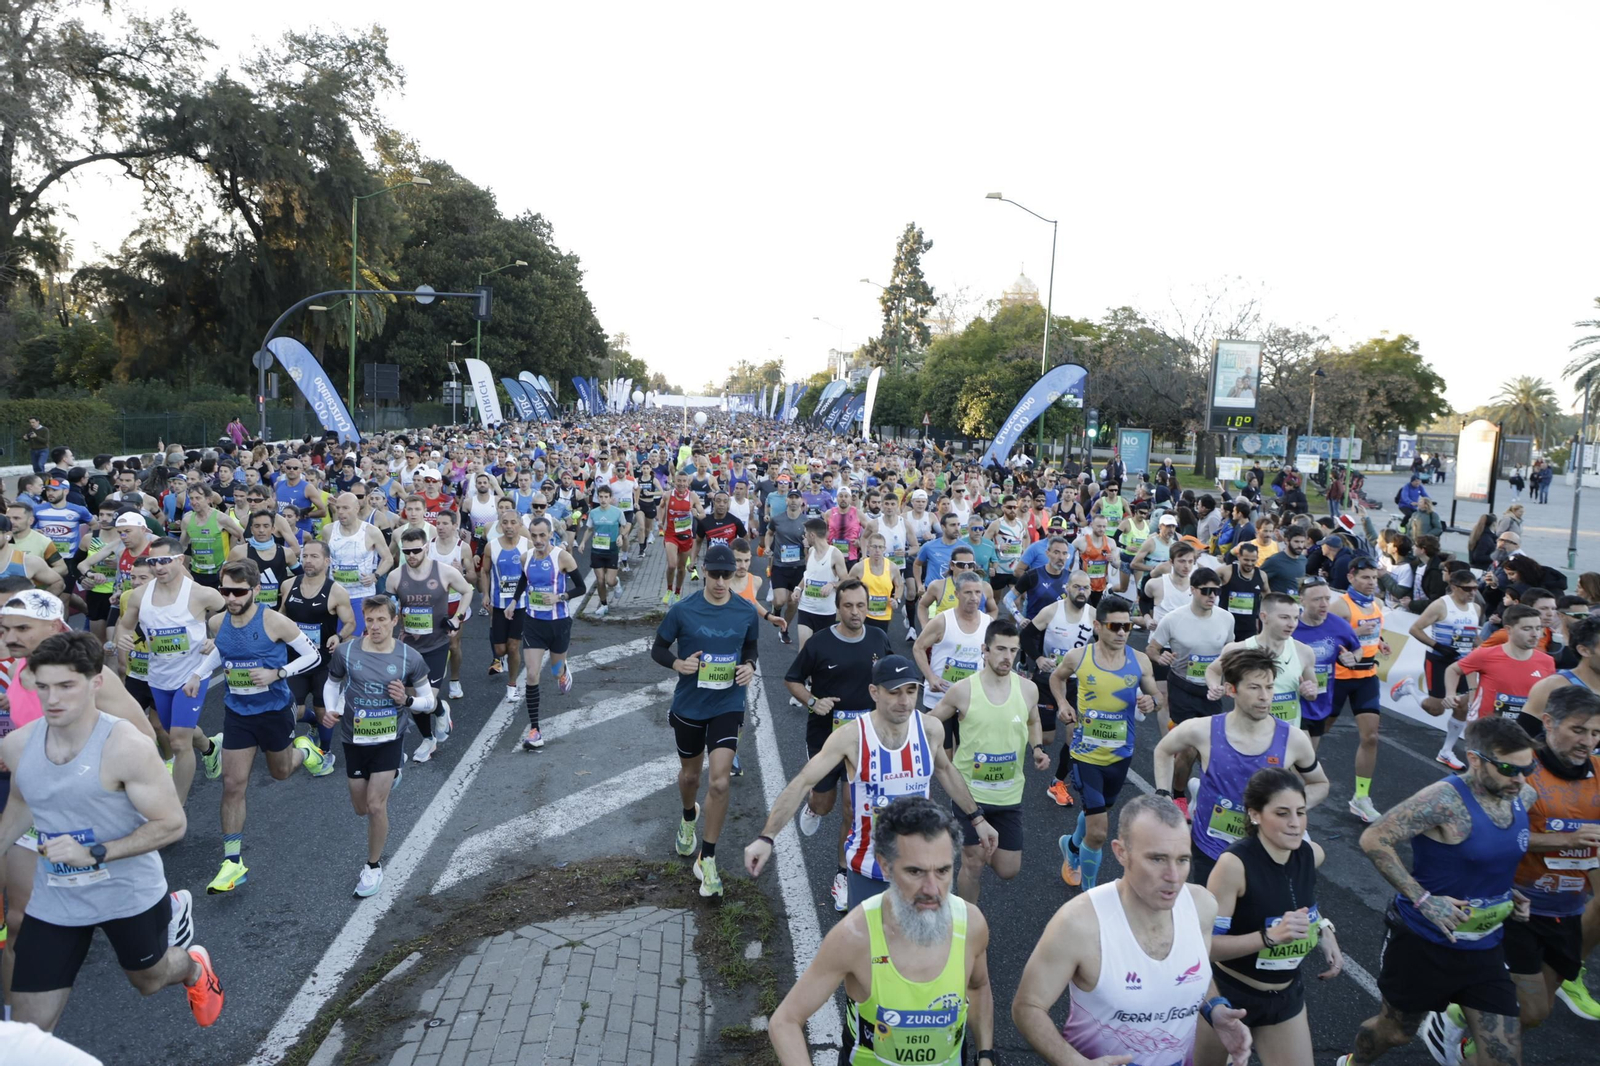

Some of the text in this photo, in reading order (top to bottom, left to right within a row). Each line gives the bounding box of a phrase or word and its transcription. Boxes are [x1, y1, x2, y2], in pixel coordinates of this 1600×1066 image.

[825, 406, 839, 426] ABC
[839, 407, 854, 429] ABC
[995, 396, 1035, 445] Cruzcampo
[1122, 436, 1138, 446] NO
[406, 594, 432, 602] DRT
[405, 620, 429, 628] DOMINIC
[1454, 616, 1472, 625] aula
[157, 644, 181, 652] JONAN
[956, 661, 975, 669] ZURICH
[709, 673, 729, 681] HUGO
[1099, 712, 1123, 720] ZURICH
[354, 725, 396, 736] MONSANTO
[1092, 729, 1117, 739] MIGUE
[989, 754, 1014, 762] ZURICH
[984, 773, 1004, 781] ALEX
[905, 1013, 951, 1025] ZURICH
[1109, 1010, 1152, 1023] SIERRA
[1153, 1012, 1165, 1021] DE
[905, 1034, 930, 1044] 1610
[895, 1047, 936, 1062] VAGO
